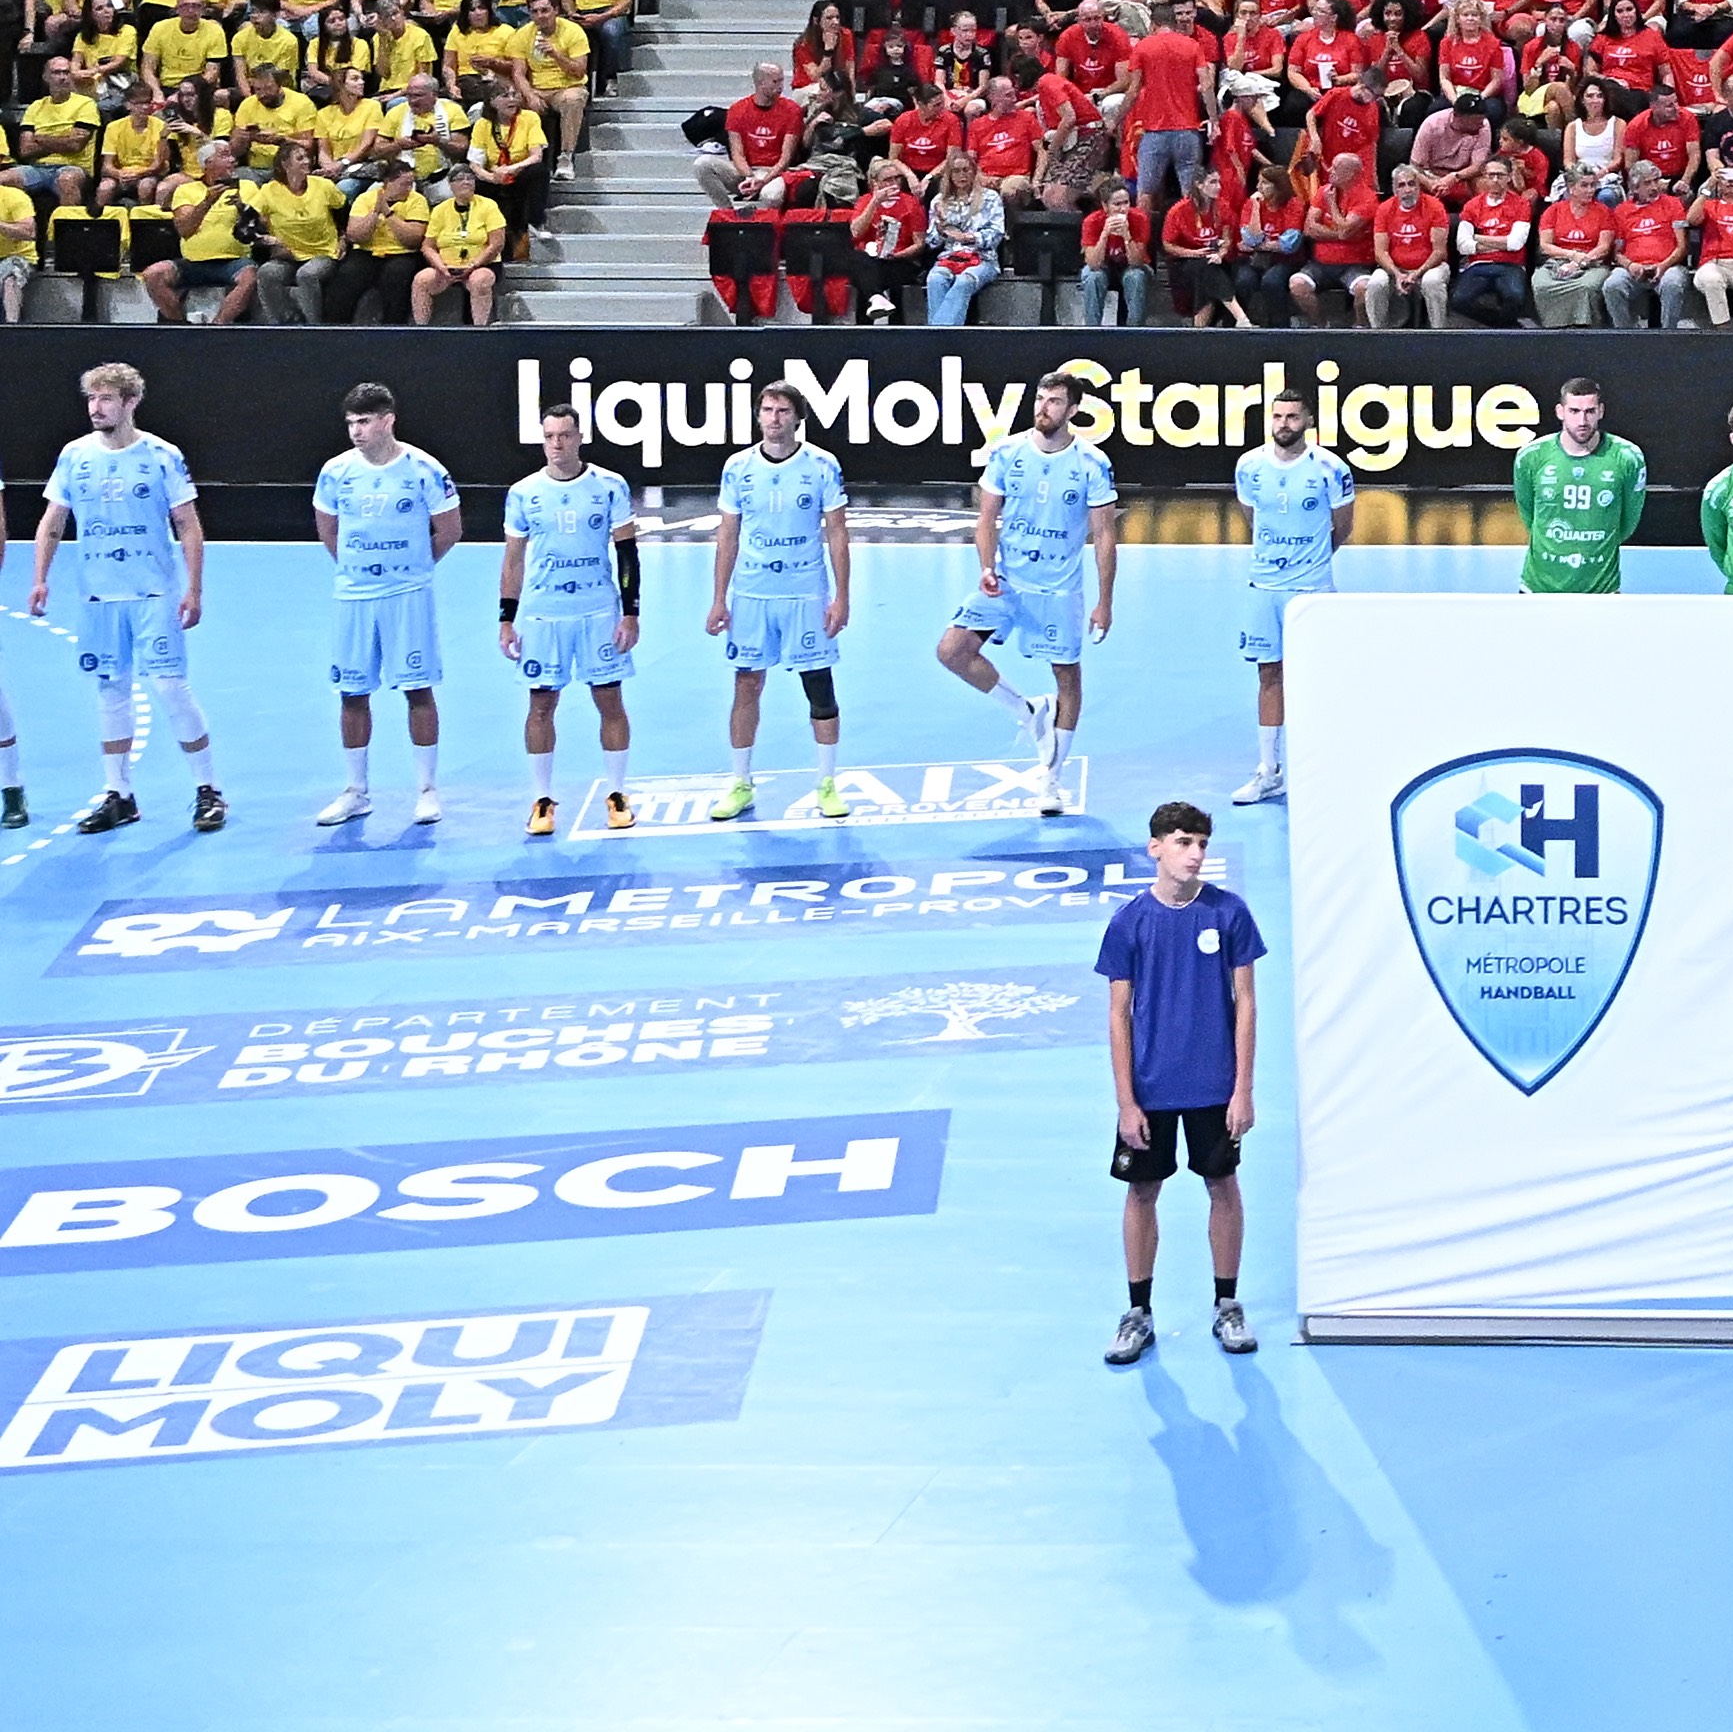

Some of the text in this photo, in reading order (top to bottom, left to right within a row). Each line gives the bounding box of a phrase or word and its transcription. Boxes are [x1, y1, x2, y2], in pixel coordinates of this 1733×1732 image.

[517, 355, 1540, 471] Liqui Moly StarLigue
[768, 490, 783, 513] 11
[1036, 481, 1049, 504] 9
[1276, 493, 1290, 514] 3
[1563, 484, 1592, 509] 99
[360, 494, 389, 517] 27
[554, 510, 577, 533] 19
[1545, 528, 1606, 543] AQUALTER
[1427, 895, 1629, 928] CHARTRES
[1466, 953, 1586, 976] MÉTROPOLE
[1480, 985, 1577, 1001] HANDBALL
[249, 992, 782, 1039] DÉPARTEMENT
[3, 1137, 901, 1248] BOSCH
[66, 1311, 622, 1395] LIQUI
[24, 1368, 612, 1458] MOLY
